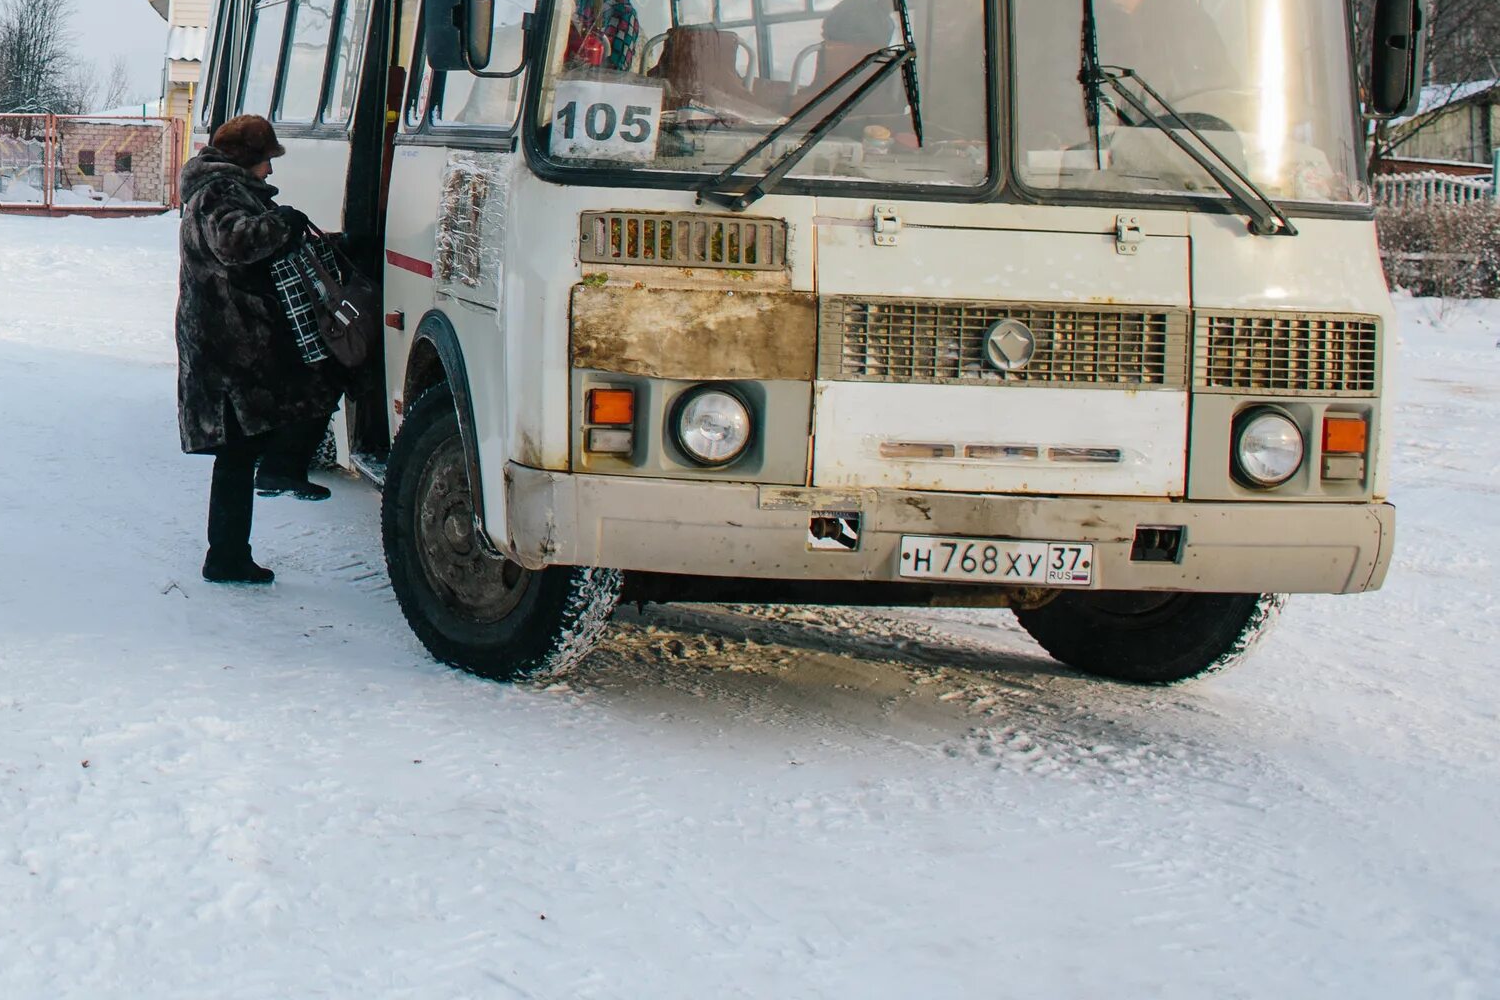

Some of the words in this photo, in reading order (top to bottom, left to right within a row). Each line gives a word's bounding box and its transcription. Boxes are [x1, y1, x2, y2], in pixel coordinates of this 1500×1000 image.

[556, 100, 652, 144] 105
[1052, 547, 1081, 570] 37
[1049, 570, 1071, 580] RUS
